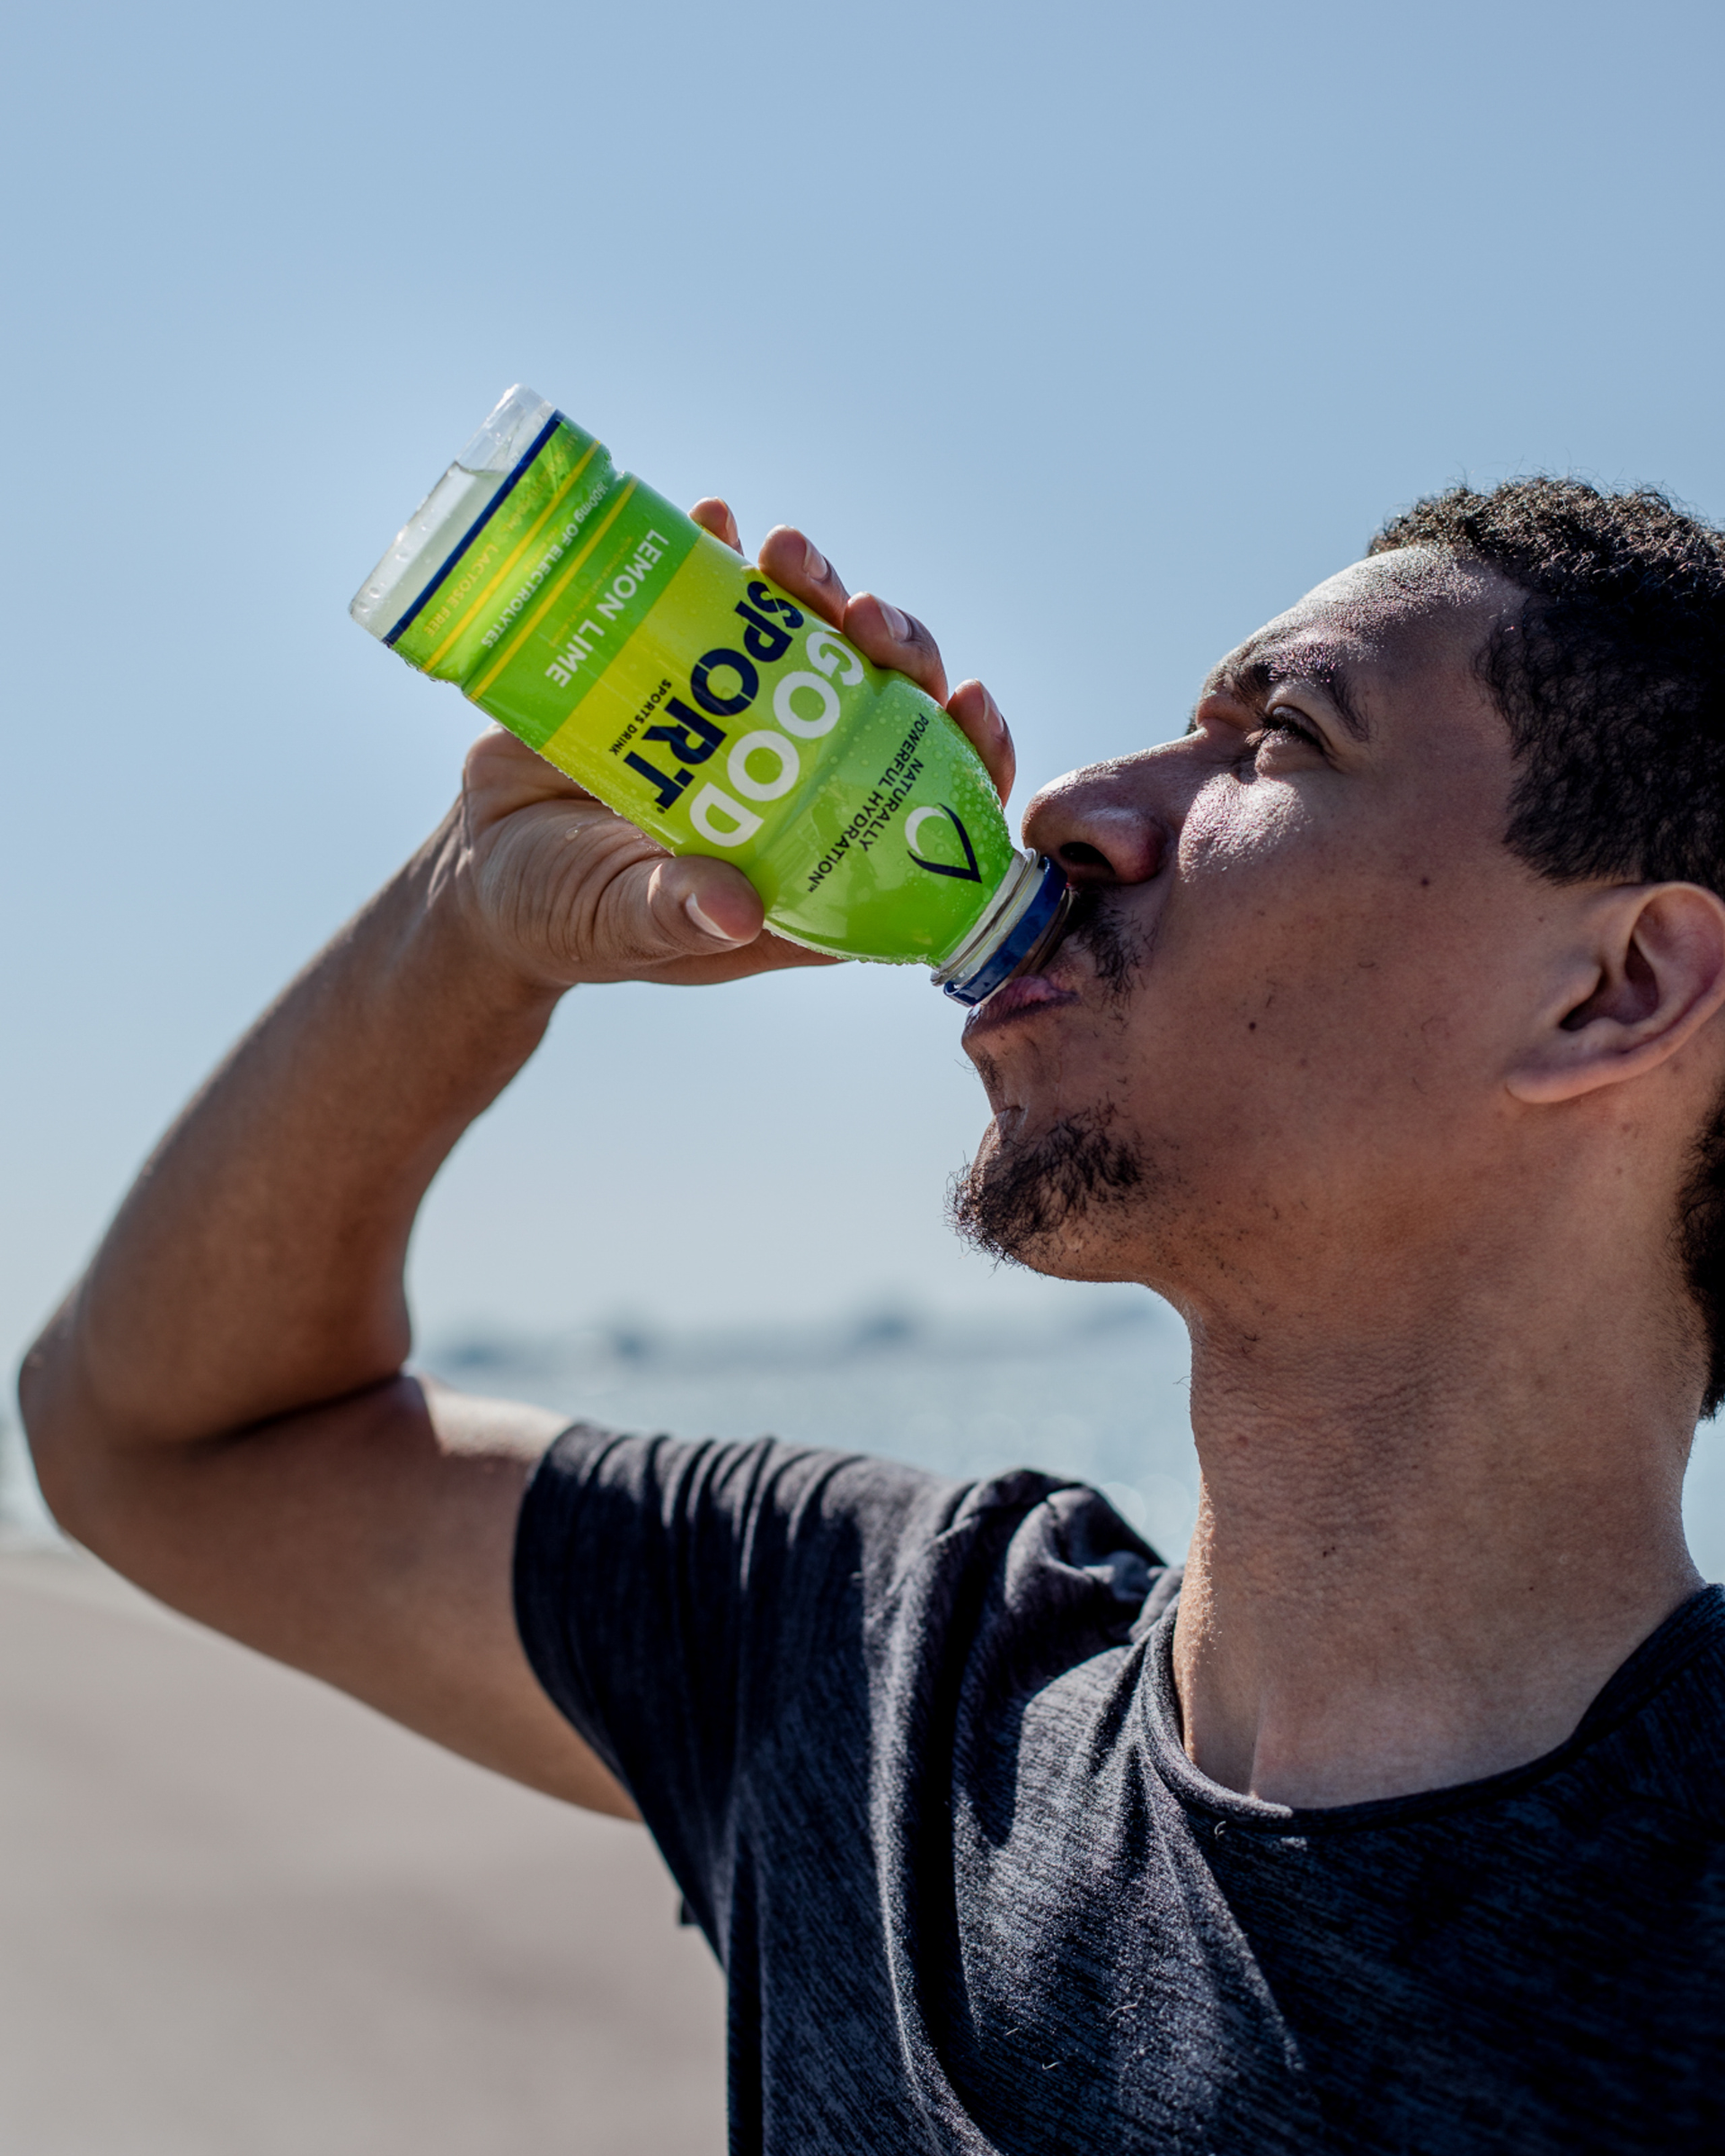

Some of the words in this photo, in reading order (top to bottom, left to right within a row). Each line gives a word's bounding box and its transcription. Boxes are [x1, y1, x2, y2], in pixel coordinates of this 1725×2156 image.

[561, 522, 579, 545] OF
[443, 542, 500, 609] LACTOSE
[480, 542, 564, 649] ELECTROLYTES
[596, 529, 668, 620] LEMON
[420, 604, 452, 638] FREE
[544, 619, 604, 687] LIME
[634, 678, 671, 723] SPORTS
[608, 723, 637, 755] DRINK
[689, 624, 864, 846] GOOD
[878, 712, 929, 786] POWERFUL
[859, 757, 924, 851] NATURALLY
